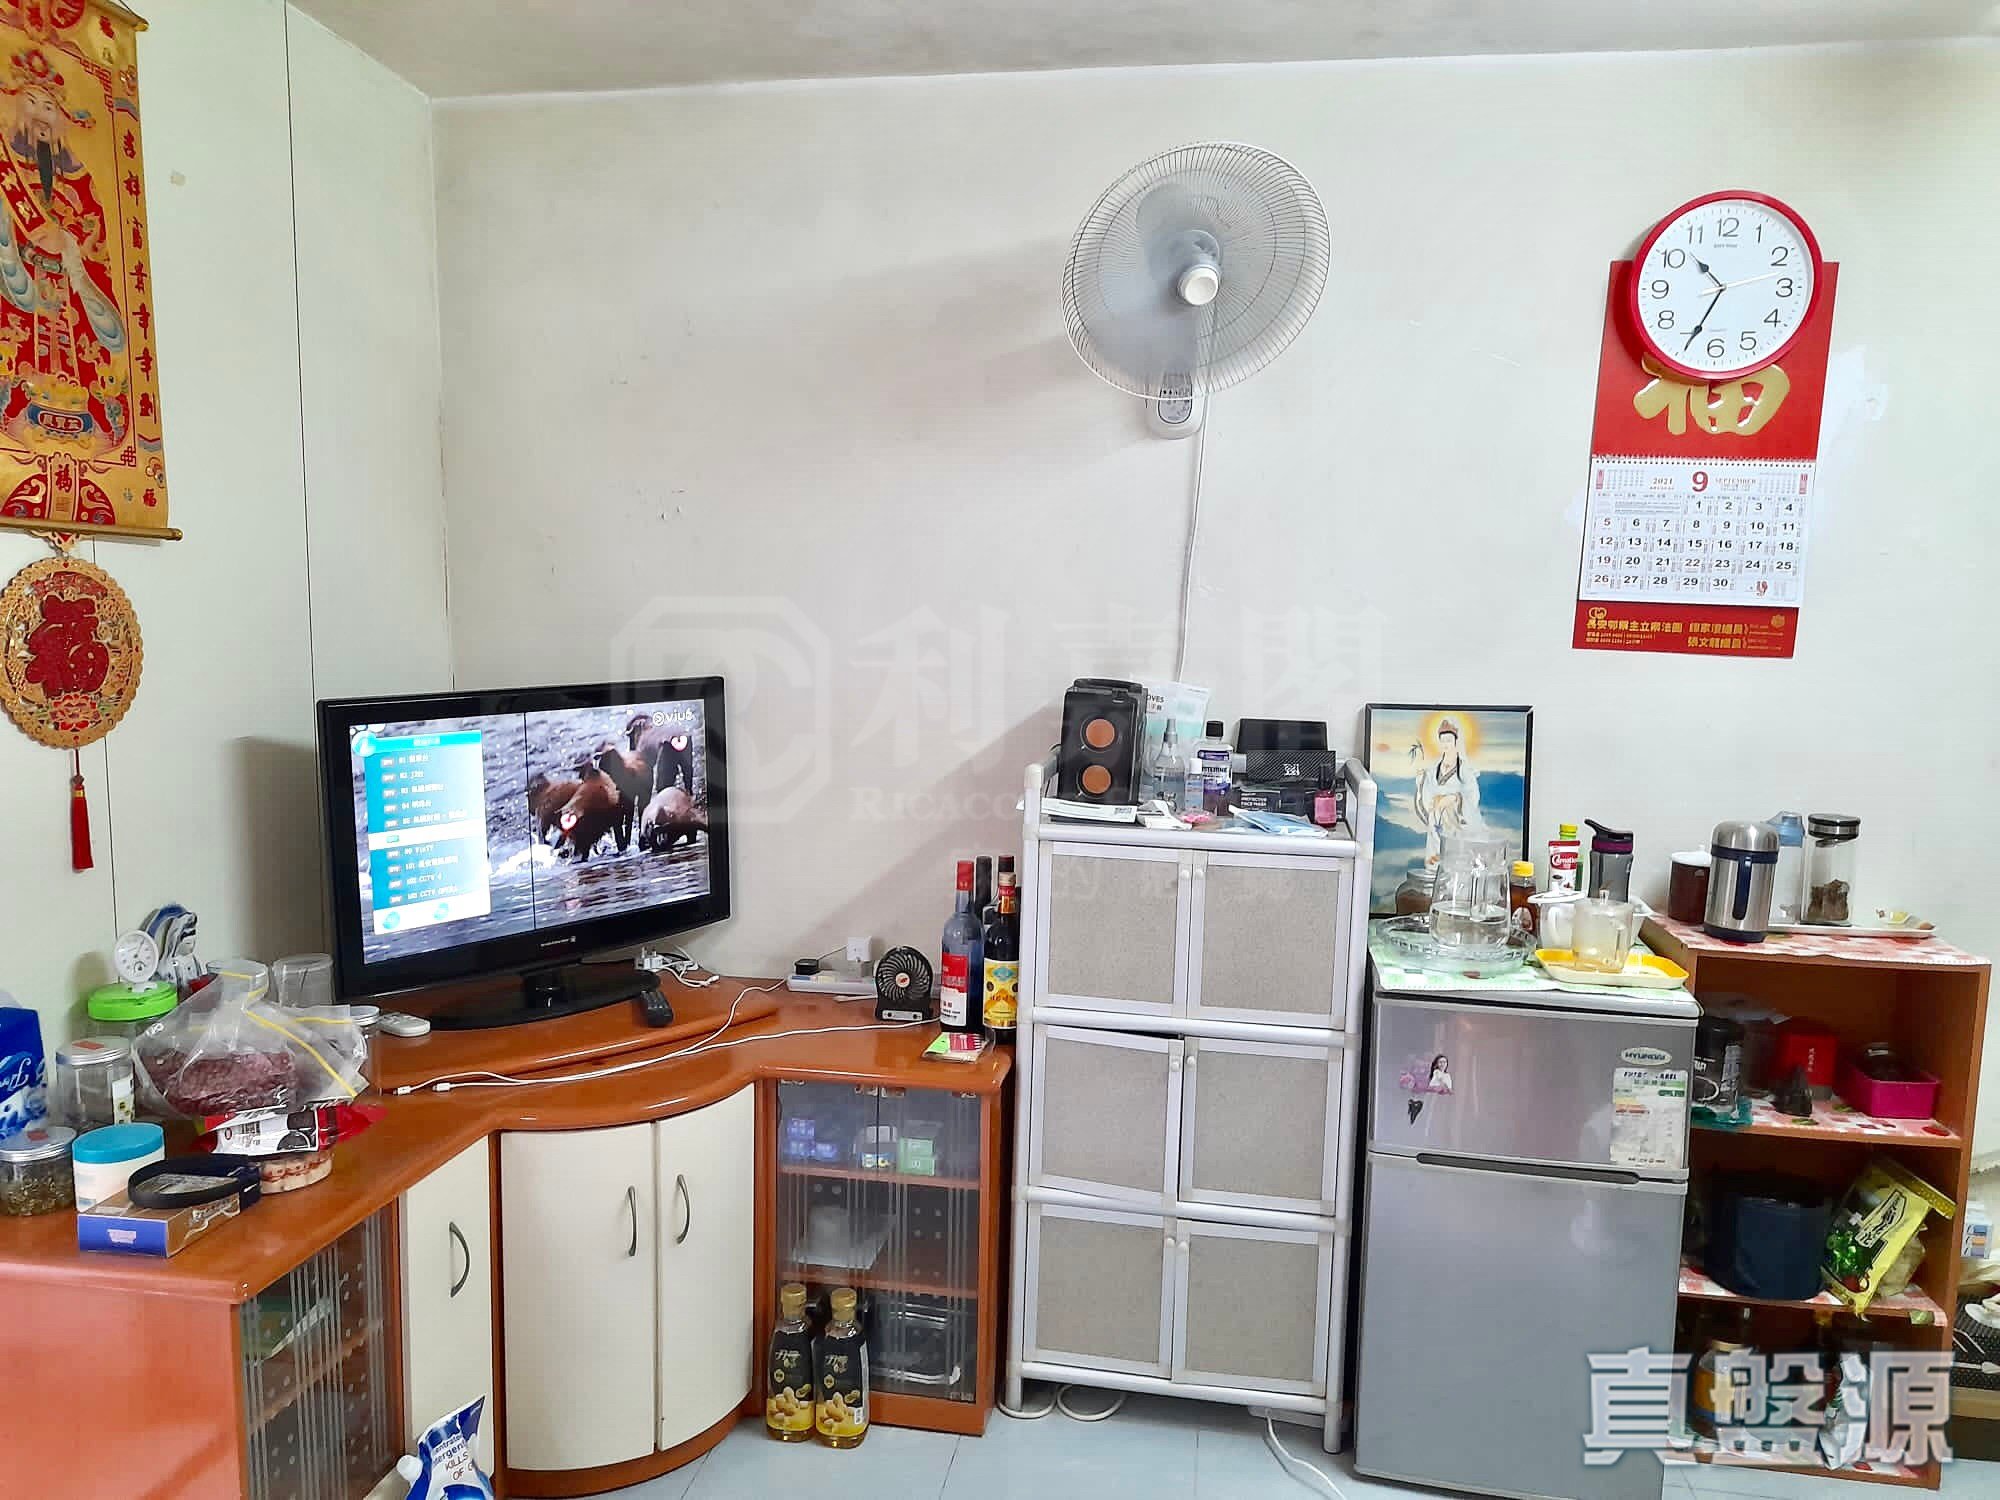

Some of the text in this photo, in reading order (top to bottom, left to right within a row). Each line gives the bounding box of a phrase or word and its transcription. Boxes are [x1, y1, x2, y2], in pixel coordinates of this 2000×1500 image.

[1687, 224, 1762, 244] 11 1
[1717, 217, 1740, 237] 12
[1661, 247, 1789, 268] 10 2
[1651, 278, 1793, 299] 9 3
[1657, 309, 1782, 329] 8 4
[1707, 339, 1724, 358] 6
[1739, 332, 1757, 350] 5
[1652, 477, 1673, 485] 2021
[1692, 471, 1709, 493] 9
[1696, 500, 1793, 512] 1 2 3 4
[1603, 517, 1795, 531] 5 6 7 8 9 10 11
[1600, 536, 1794, 551] 12 13 14 15 16 17 18
[1598, 555, 1792, 570] 19 20 21 22 23 24 25
[1594, 574, 1729, 587] 26 27 28 29 30
[445, 1452, 469, 1471] KILLS
[453, 1468, 464, 1480] OF
